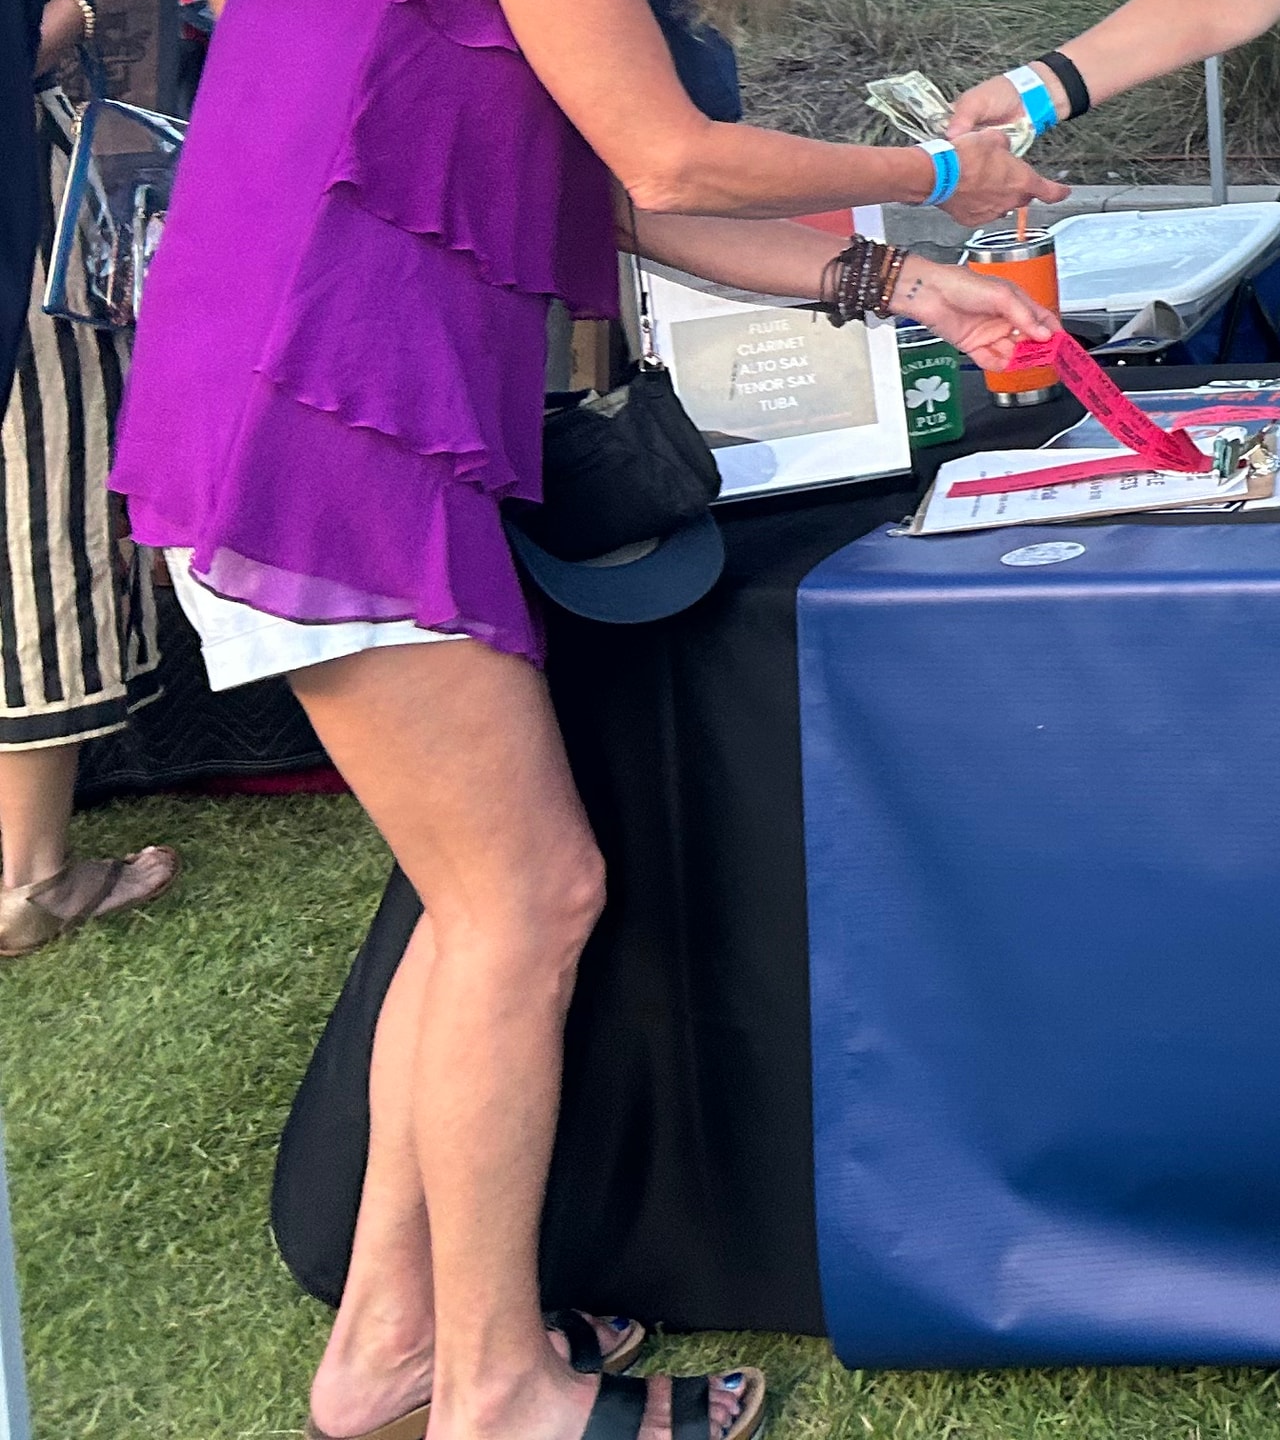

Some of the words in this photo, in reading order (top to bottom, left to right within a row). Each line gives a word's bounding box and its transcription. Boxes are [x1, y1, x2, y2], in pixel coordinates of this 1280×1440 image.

[749, 319, 791, 335] FLUTE
[737, 336, 806, 356] CLARINET
[740, 361, 777, 376] ALTO
[779, 355, 809, 369] SAX
[736, 377, 785, 395] TENOR
[787, 372, 817, 389] SAX
[758, 395, 799, 412] TUBA
[916, 412, 947, 428] PUB
